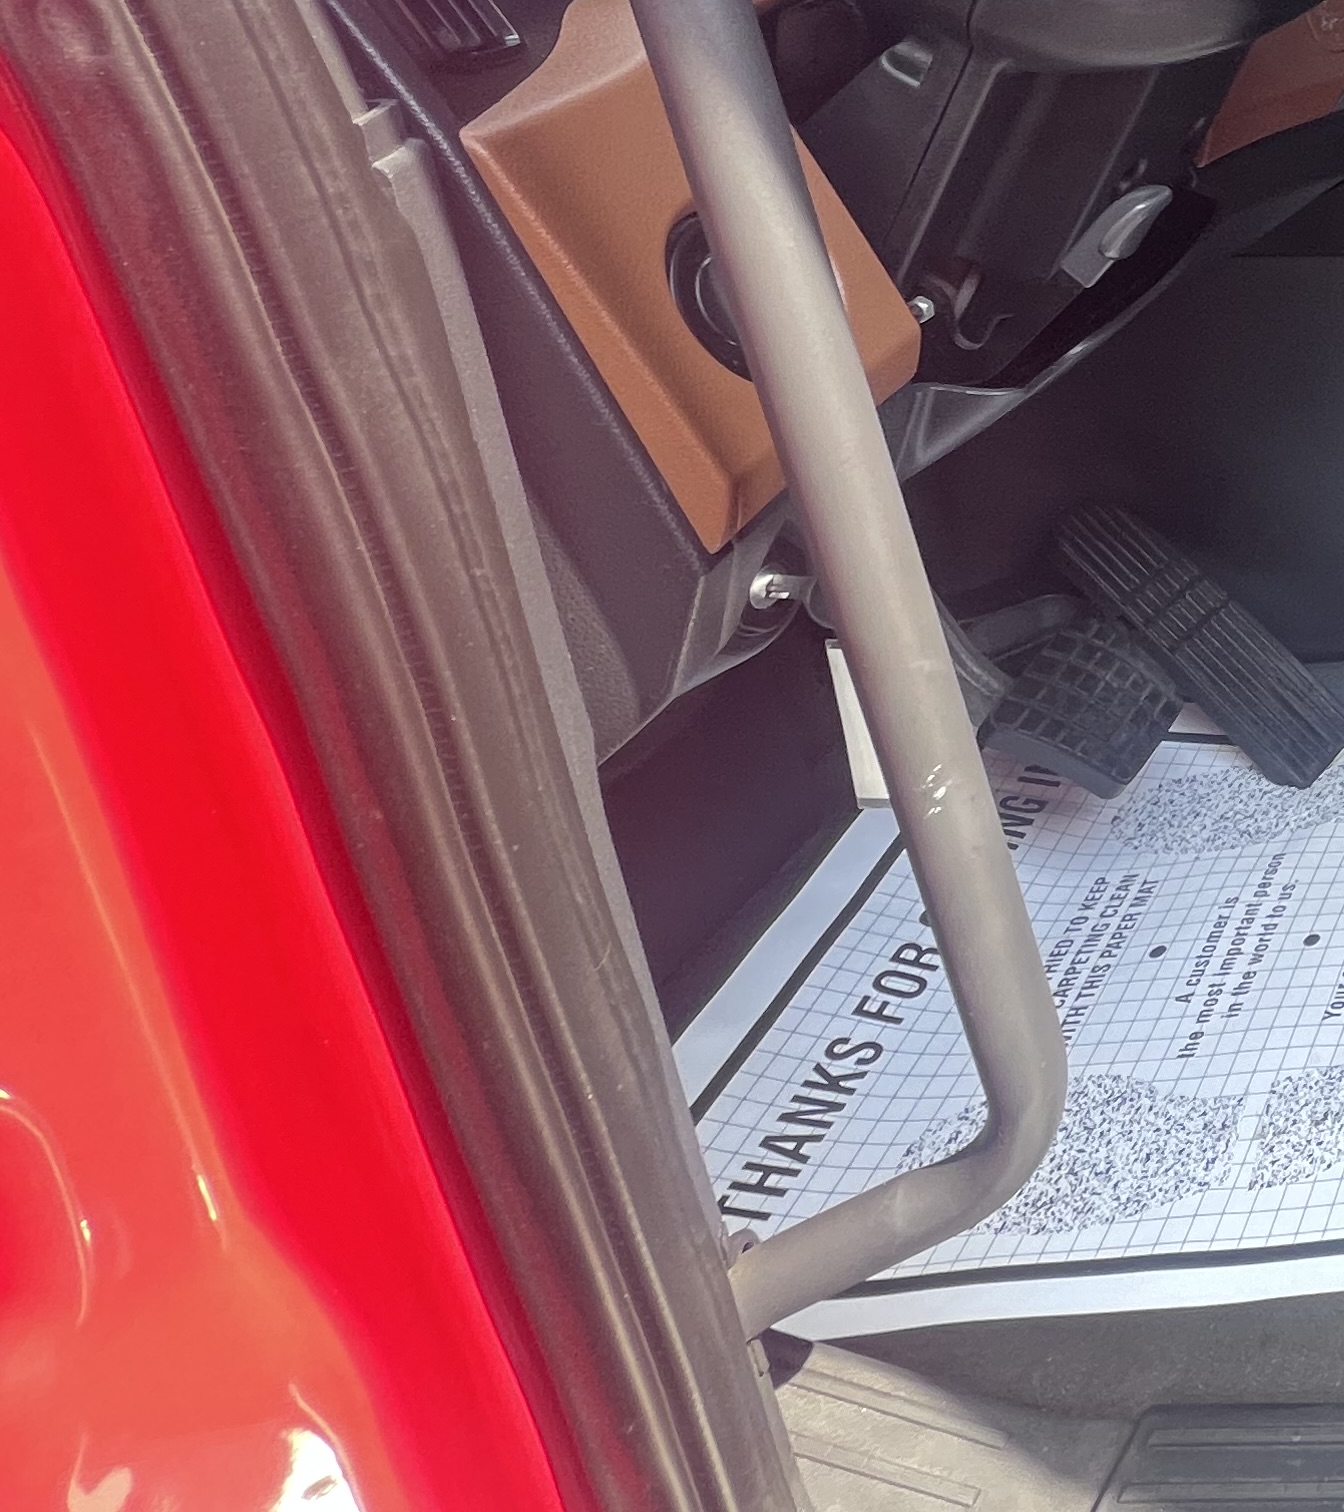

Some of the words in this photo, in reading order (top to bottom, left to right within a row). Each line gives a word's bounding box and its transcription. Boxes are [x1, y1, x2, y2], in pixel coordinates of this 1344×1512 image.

[1100, 873, 1140, 920] CLEAN
[1265, 904, 1287, 919] to
[1278, 879, 1299, 901] us.
[1044, 939, 1074, 981] RIED
[1064, 915, 1089, 935] TO
[1077, 877, 1111, 911] KEEP
[1075, 964, 1111, 1002] THIS
[1100, 912, 1142, 959] PAPER
[1129, 879, 1159, 908] MAT
[1175, 991, 1195, 1004] A
[1186, 913, 1230, 988] customer
[1218, 896, 1239, 910] is
[1248, 923, 1279, 967] world
[1177, 1030, 1205, 1059] the
[1196, 980, 1226, 1025] most
[1213, 903, 1263, 976] important
[1253, 852, 1287, 899] person
[1231, 971, 1257, 997] the
[1220, 1001, 1244, 1019] in
[721, 1035, 884, 1222] THANKS
[851, 940, 944, 1025] FOR
